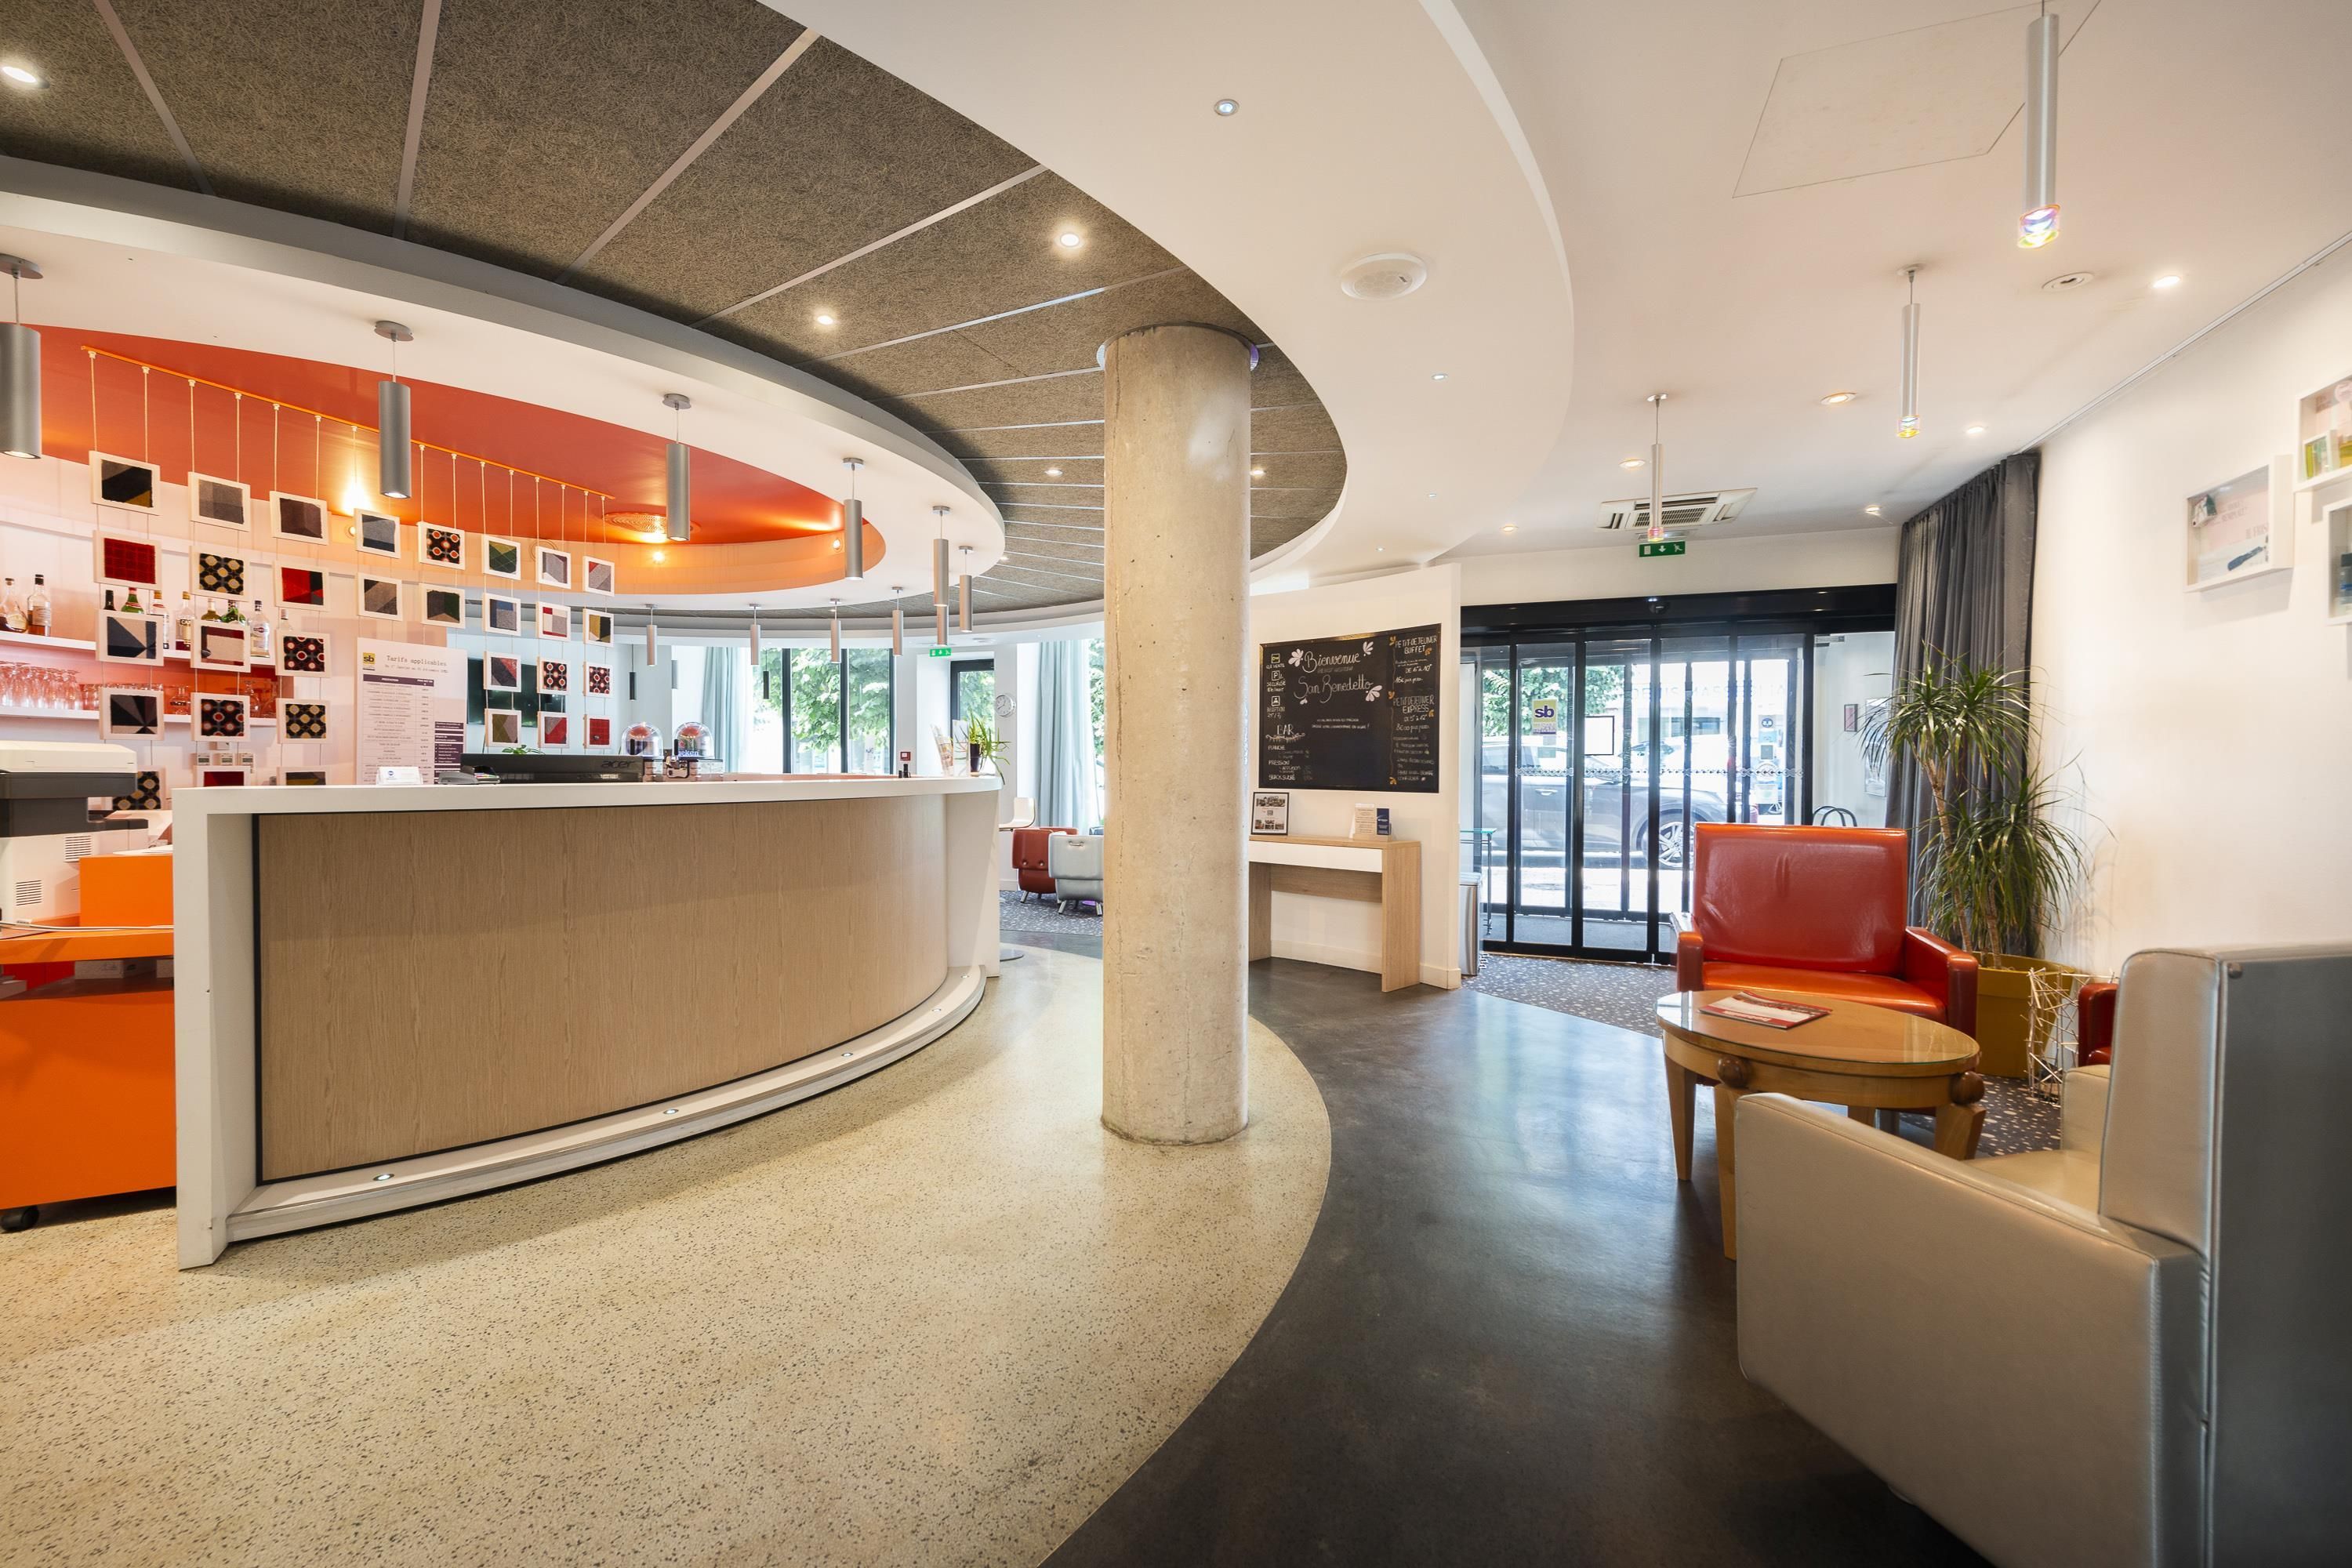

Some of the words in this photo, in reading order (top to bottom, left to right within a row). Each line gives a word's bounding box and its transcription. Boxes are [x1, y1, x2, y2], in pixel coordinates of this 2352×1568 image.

[1404, 645, 1425, 654] BUFFET
[410, 658, 447, 666] applicables
[1302, 652, 1360, 673] Bienvenue
[1294, 676, 1320, 699] San
[1319, 674, 1374, 703] Benedetto
[1534, 706, 1555, 718] sb
[1277, 724, 1294, 735] BAR
[601, 760, 635, 768] acer
